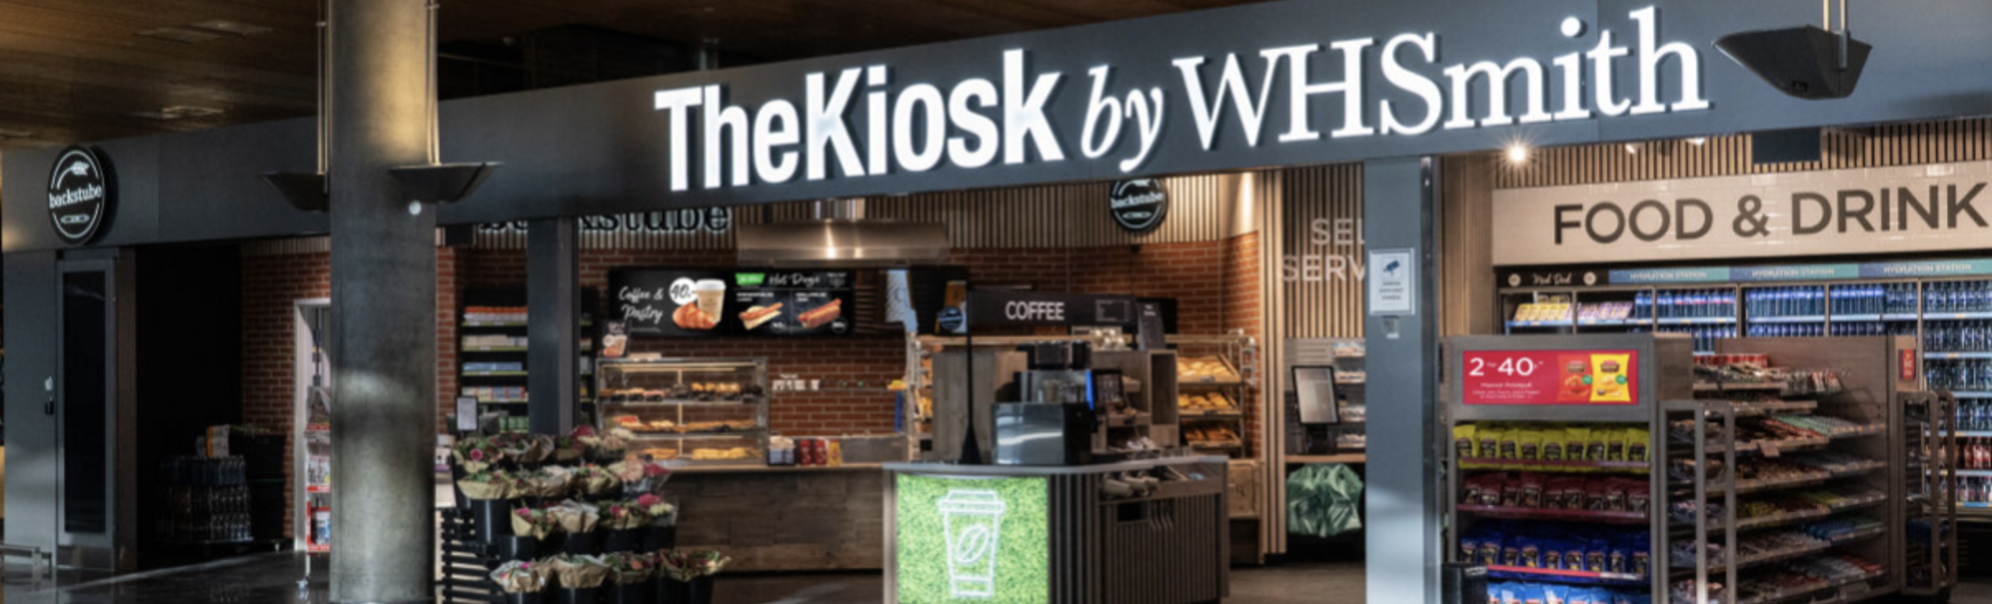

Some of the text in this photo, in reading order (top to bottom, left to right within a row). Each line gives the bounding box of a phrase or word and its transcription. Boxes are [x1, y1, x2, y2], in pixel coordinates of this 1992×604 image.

[654, 5, 1709, 191] TheKiosk by WHSmith
[49, 183, 102, 209] backstube
[1554, 182, 1989, 245] FOOD & DRINK
[1883, 262, 1972, 275] HYDRATION STATION
[618, 285, 650, 303] Coffee
[621, 303, 663, 325] Pastry
[1004, 299, 1066, 321] COFFEE
[1468, 356, 1485, 377] 2
